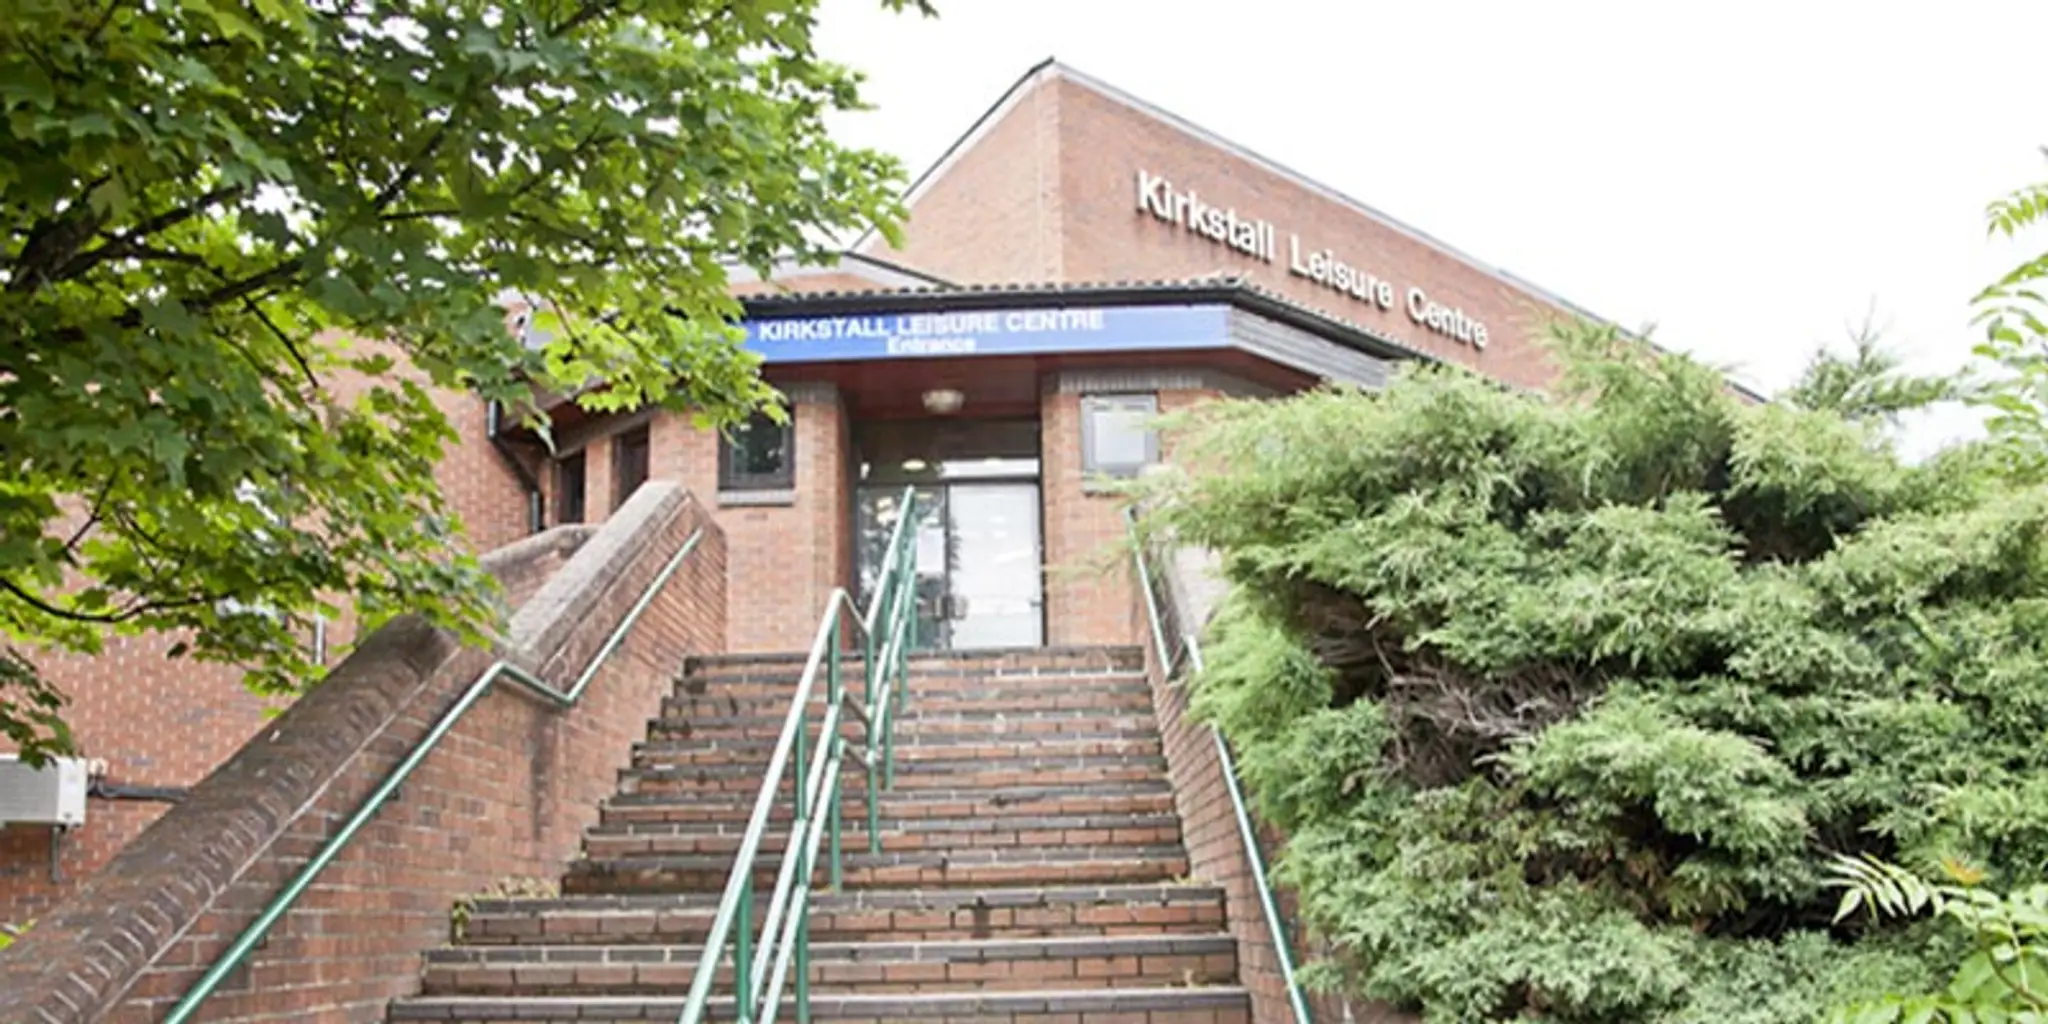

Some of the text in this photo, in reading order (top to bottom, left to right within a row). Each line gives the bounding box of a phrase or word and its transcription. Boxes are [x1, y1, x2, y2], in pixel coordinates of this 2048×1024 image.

[1136, 169, 1489, 347] Kirkstall Leisure Centre
[759, 307, 1105, 341] KIRKSTALL LEISURE CENTRE
[886, 335, 977, 355] Entrance
